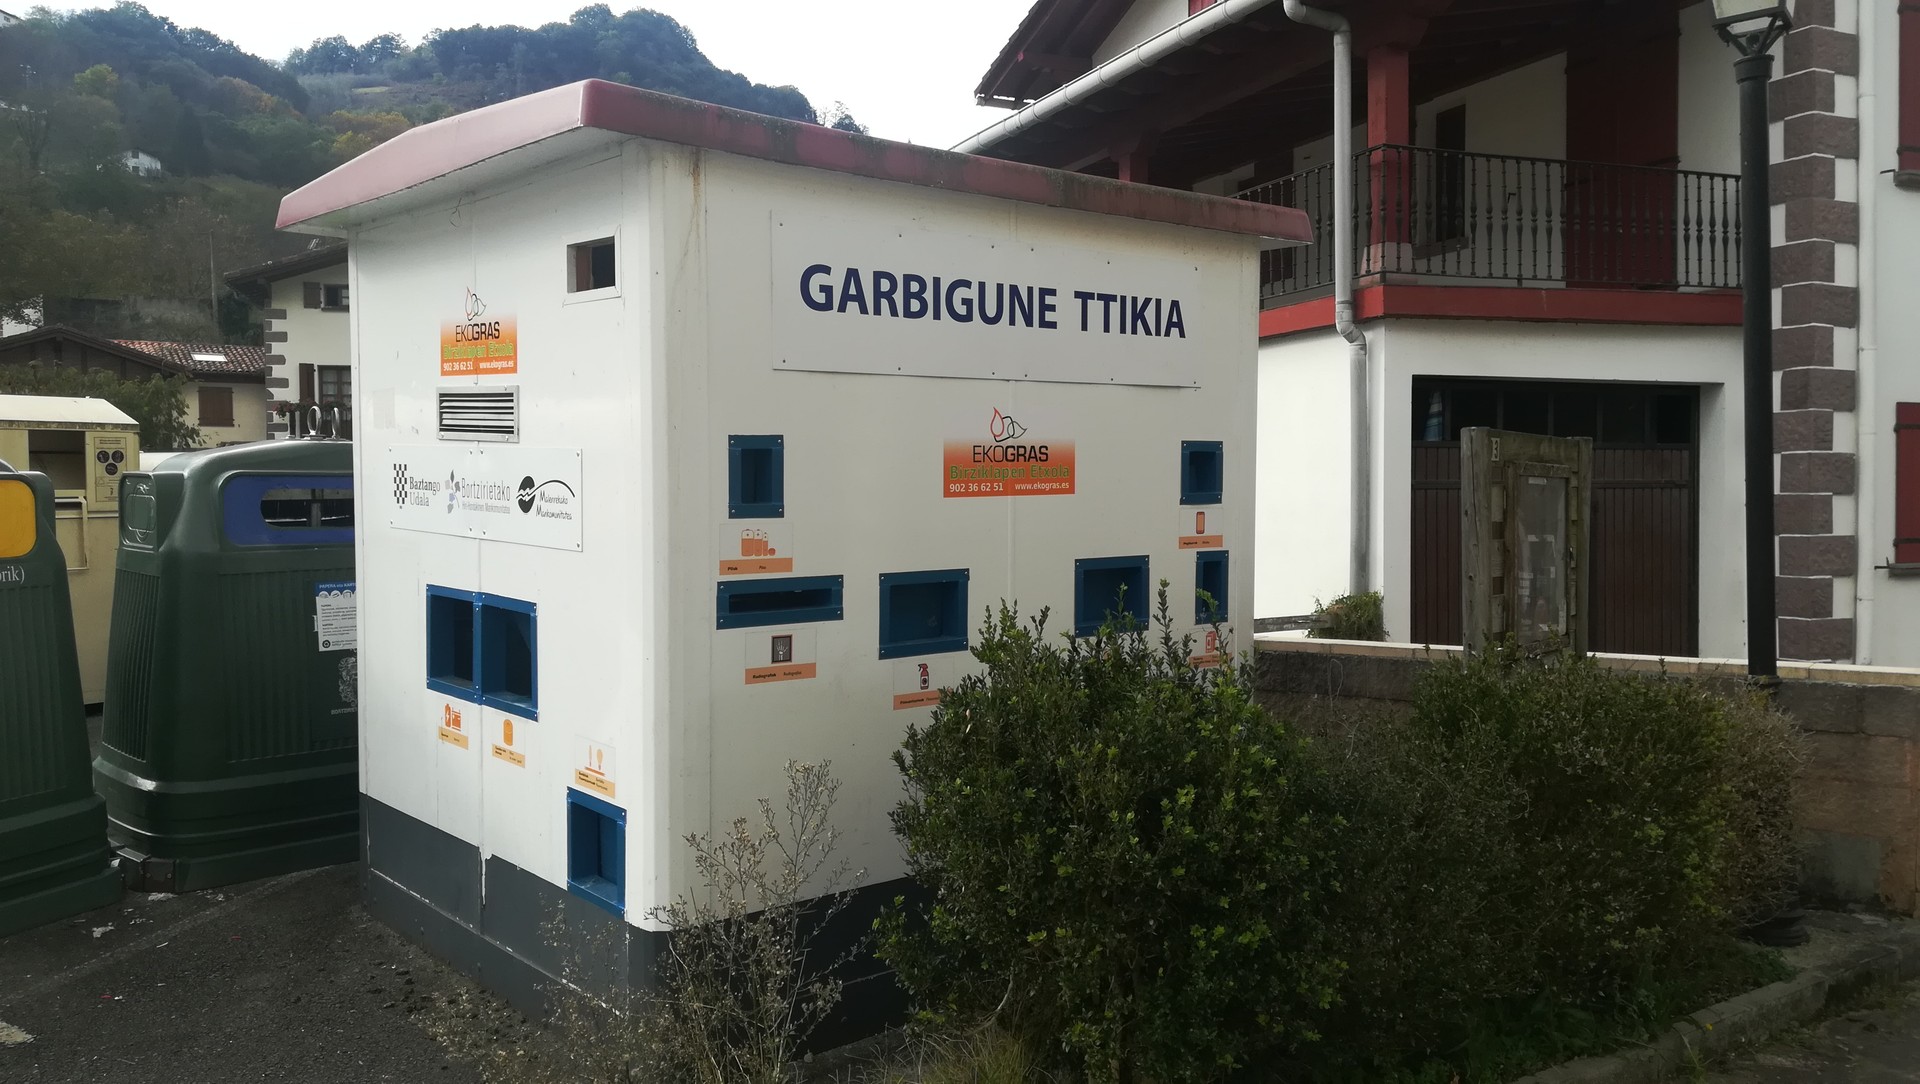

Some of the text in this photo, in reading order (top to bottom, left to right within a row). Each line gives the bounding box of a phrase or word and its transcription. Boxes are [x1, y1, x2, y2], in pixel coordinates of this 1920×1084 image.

[800, 264, 1186, 339] GARBIGUNE TTIKIA
[455, 321, 501, 343] EKOGRAS
[443, 360, 514, 371] 902 36 62 51 www.ekogras.es
[972, 445, 1049, 463] EKOGRAS
[950, 464, 1069, 481] Birziklapen Etxola
[409, 476, 441, 496] Baztango
[461, 477, 511, 502] Bortzirietako
[949, 481, 1070, 492] 902 36 62 51 www.ekogras.es
[409, 491, 430, 507] Udala
[0, 565, 25, 585] rik)
